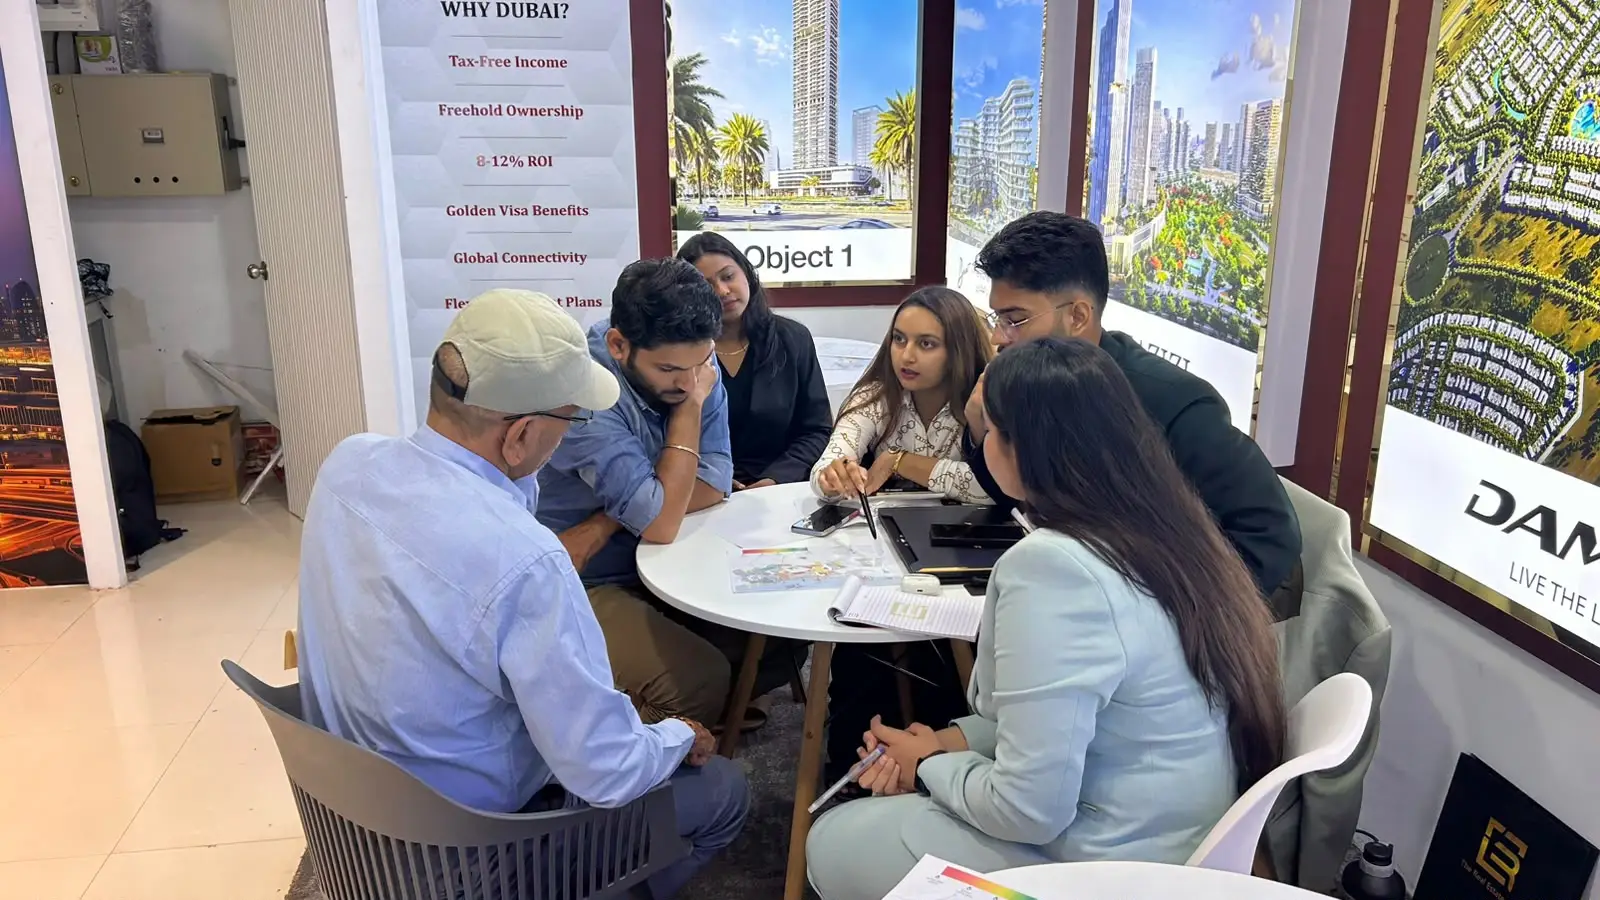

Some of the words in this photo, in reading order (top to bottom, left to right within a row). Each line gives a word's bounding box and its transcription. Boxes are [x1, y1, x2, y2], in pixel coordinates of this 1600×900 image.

[440, 1, 490, 18] WHY
[495, 1, 569, 19] DUBAI?
[448, 55, 511, 68] Tax-Free
[515, 56, 568, 69] Income
[438, 104, 502, 116] Freehold
[506, 104, 584, 120] Ownership
[476, 155, 524, 168] 8-12%
[527, 155, 553, 167] ROI
[446, 205, 496, 217] Golden
[499, 205, 529, 217] Visa
[532, 205, 589, 217] Benefits
[453, 252, 498, 264] Global
[501, 252, 588, 266] Connectivity
[744, 245, 833, 274] Object
[841, 244, 852, 267] 1
[566, 296, 602, 308] Plans
[1509, 561, 1547, 596] LIVE
[1550, 580, 1587, 617] THE
